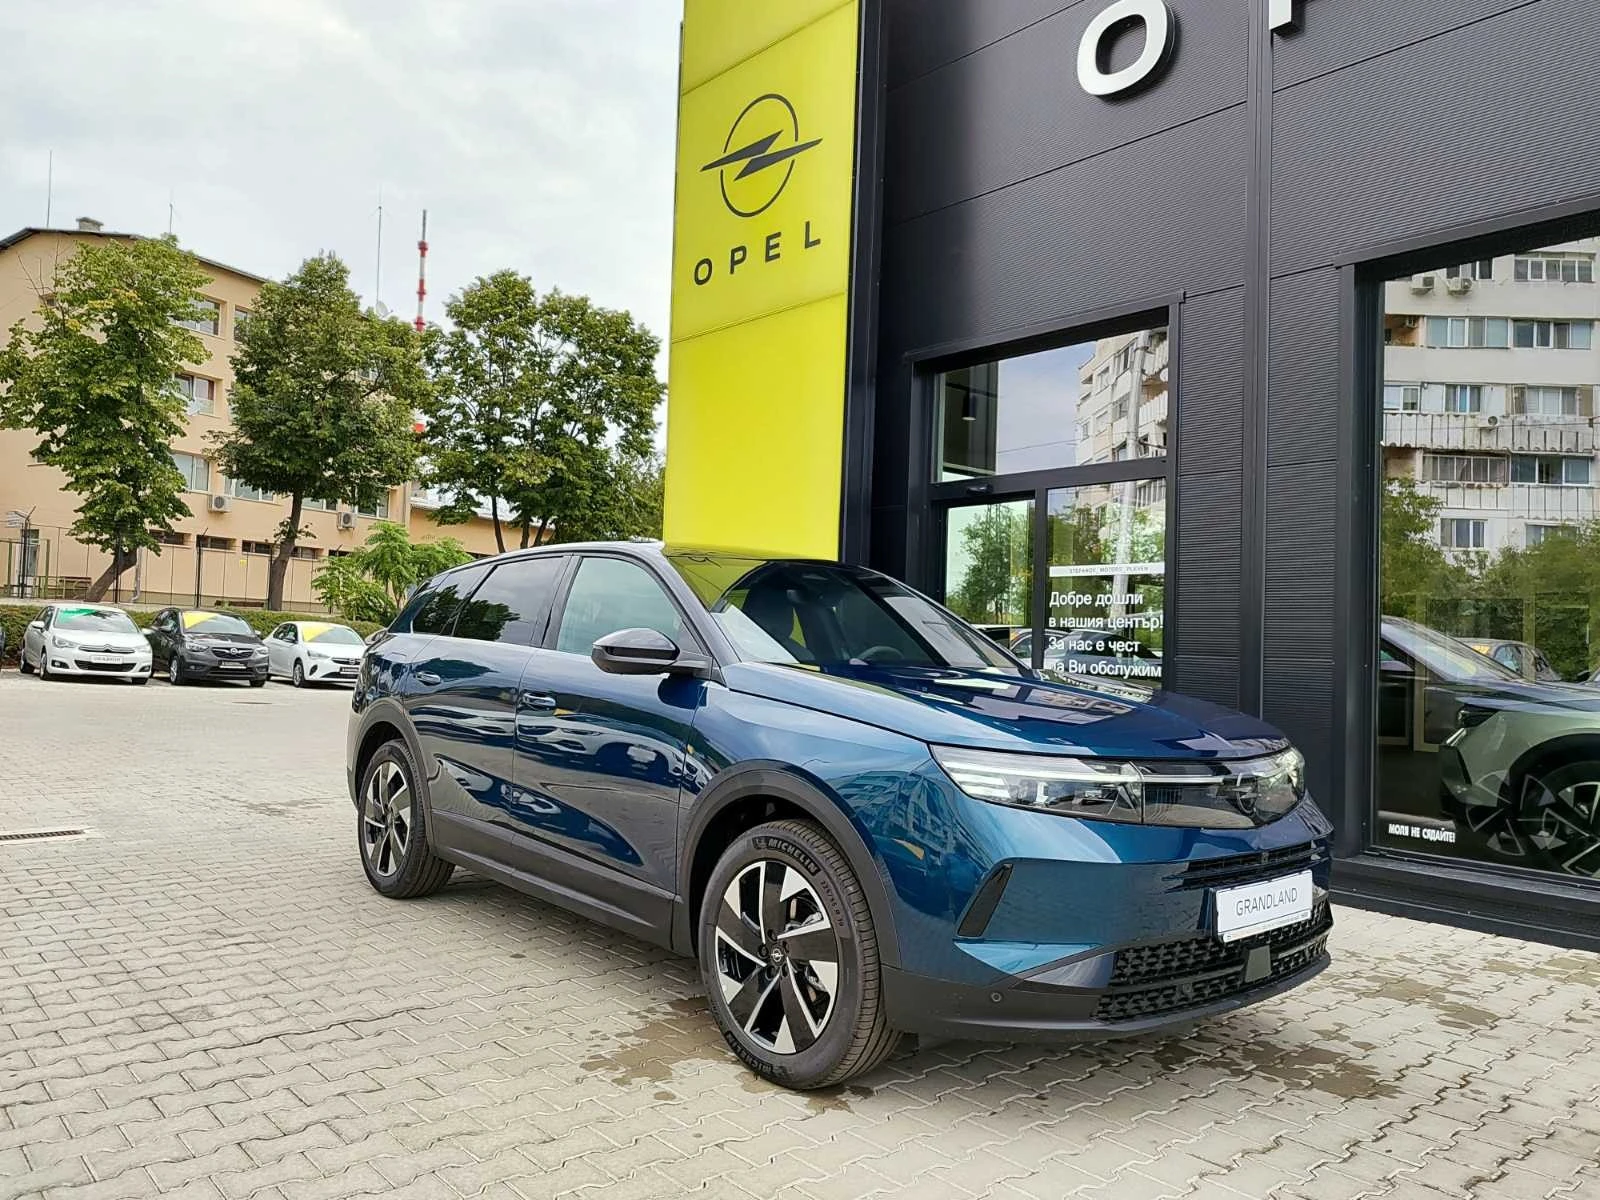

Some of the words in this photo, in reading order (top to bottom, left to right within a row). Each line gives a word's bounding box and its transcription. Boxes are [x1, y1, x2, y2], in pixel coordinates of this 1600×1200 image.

[693, 220, 821, 286] OPEL
[1049, 591, 1093, 608] Добре
[1095, 593, 1144, 607] дошли
[1048, 617, 1056, 628] в
[1060, 617, 1103, 628] нашия
[1107, 615, 1163, 631] център!
[1048, 637, 1065, 650] За
[1069, 640, 1093, 650] нас
[1095, 641, 1105, 651] е
[1108, 641, 1141, 652] чест
[1068, 659, 1086, 674] Ви
[1089, 660, 1162, 679] обслужим
[1388, 824, 1410, 837] МОЛЯ
[1411, 826, 1421, 838] НЕ
[1422, 828, 1456, 843] СЯДАЙТЕ!
[767, 837, 820, 876] MICHELIN
[1236, 887, 1298, 917] GRANDLAND
